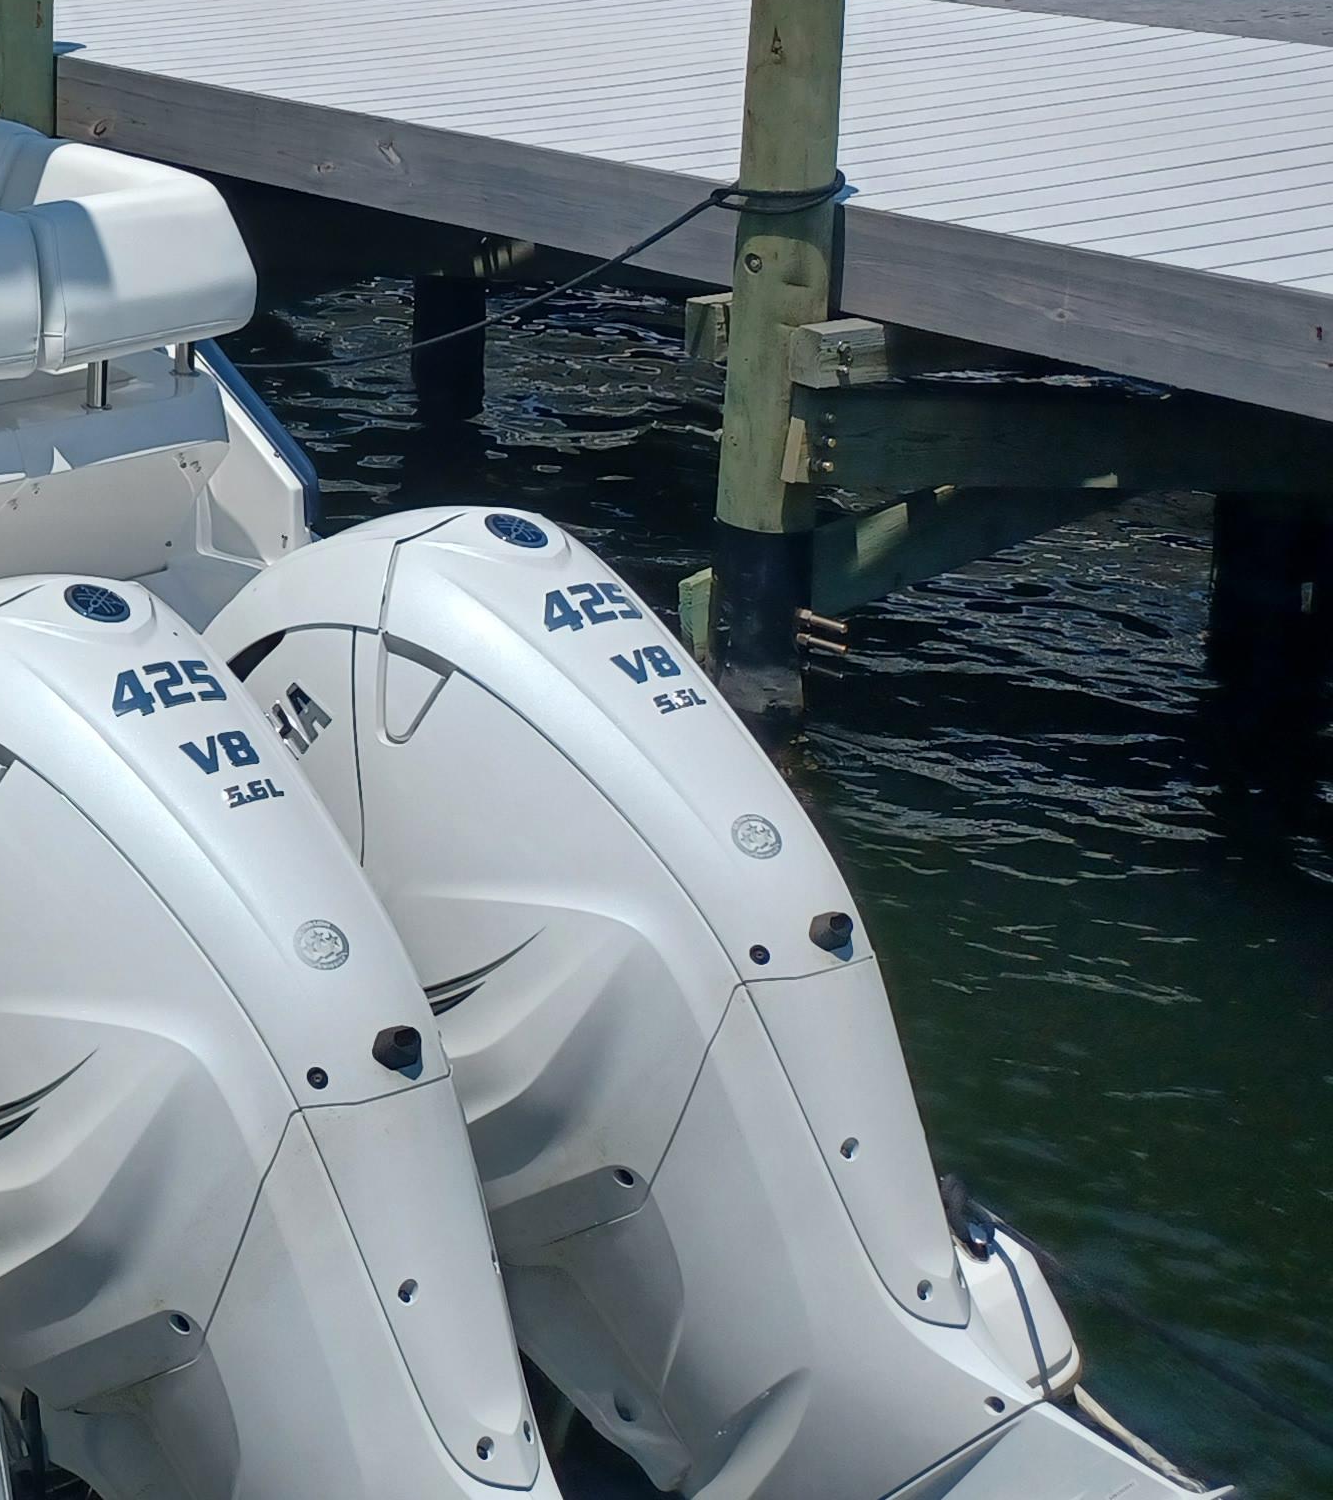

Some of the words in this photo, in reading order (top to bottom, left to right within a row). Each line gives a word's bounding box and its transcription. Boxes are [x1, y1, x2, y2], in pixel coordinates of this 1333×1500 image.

[542, 581, 643, 633] 425
[610, 645, 681, 685] V8
[112, 660, 227, 717] 425
[178, 730, 260, 775] V8
[222, 778, 285, 809] 5.6L
